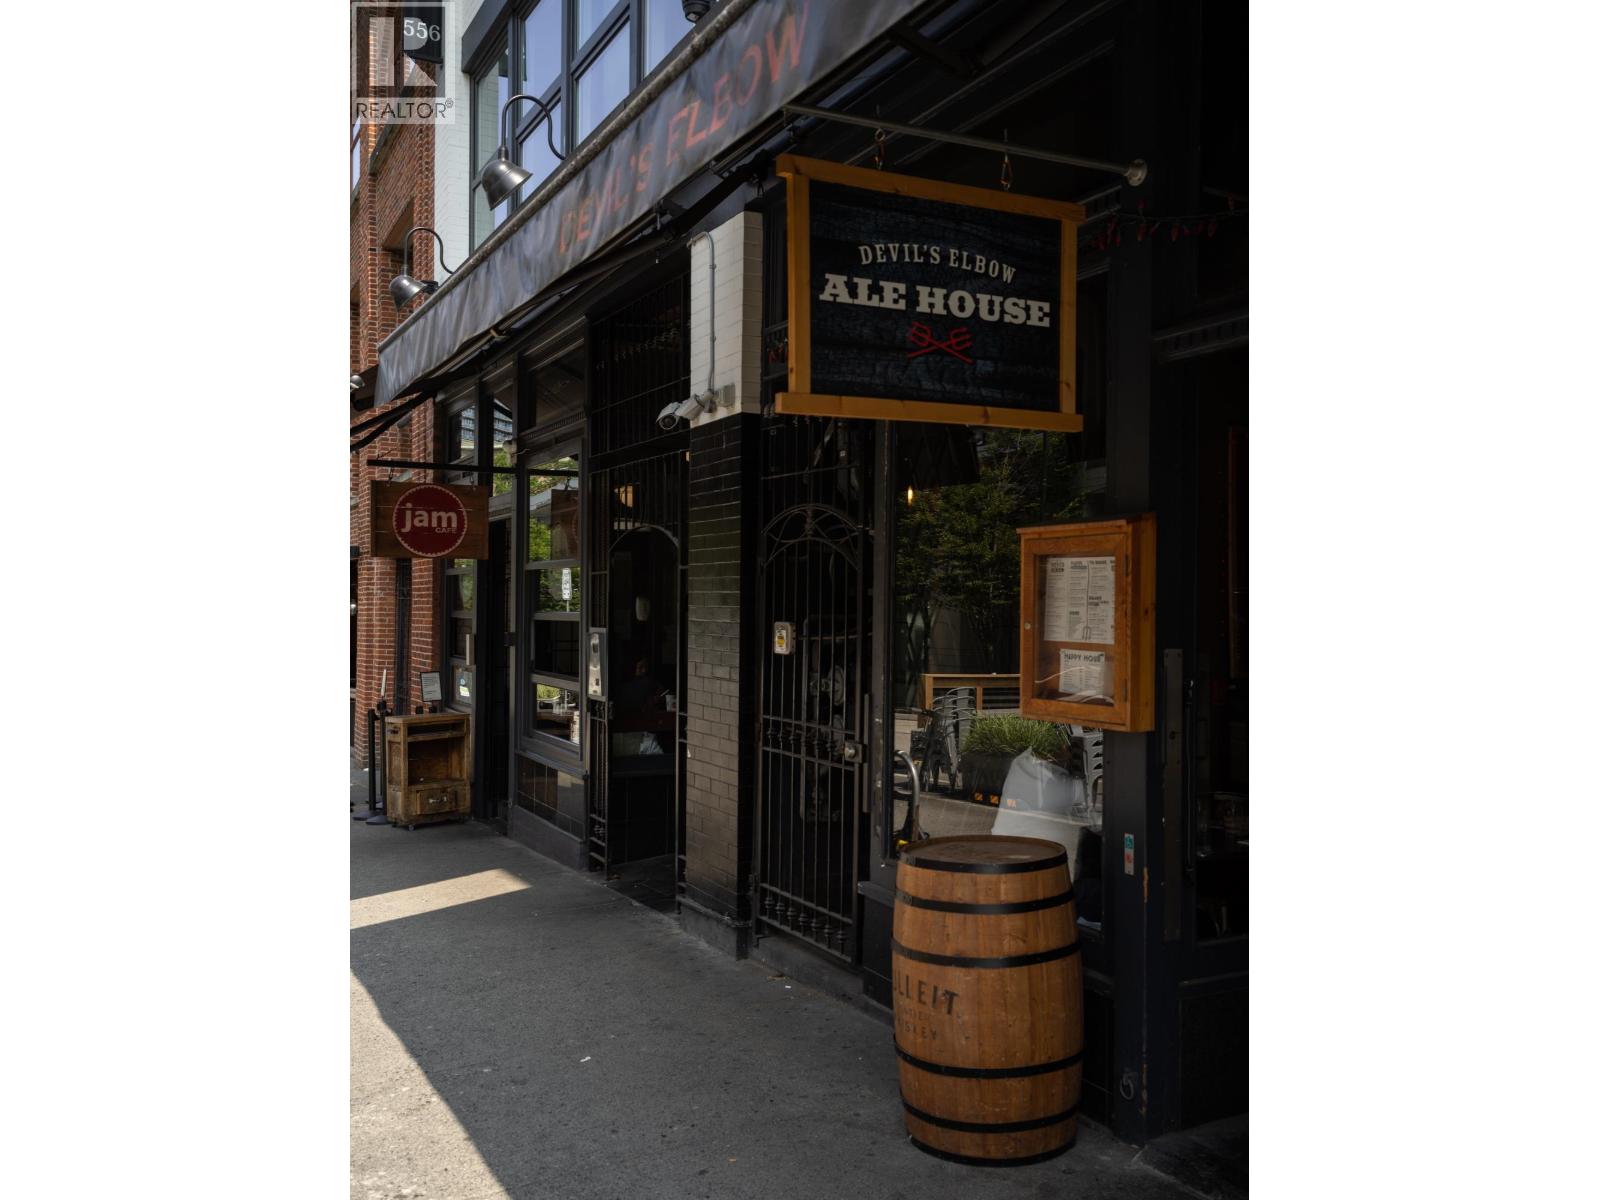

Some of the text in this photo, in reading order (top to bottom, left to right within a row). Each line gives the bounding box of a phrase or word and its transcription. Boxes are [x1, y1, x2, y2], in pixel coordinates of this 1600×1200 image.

[403, 19, 441, 42] 556
[858, 242, 1017, 284] DEVIL'S ELBOW
[819, 273, 1050, 328] ALE HOUSE
[400, 502, 458, 532] jam
